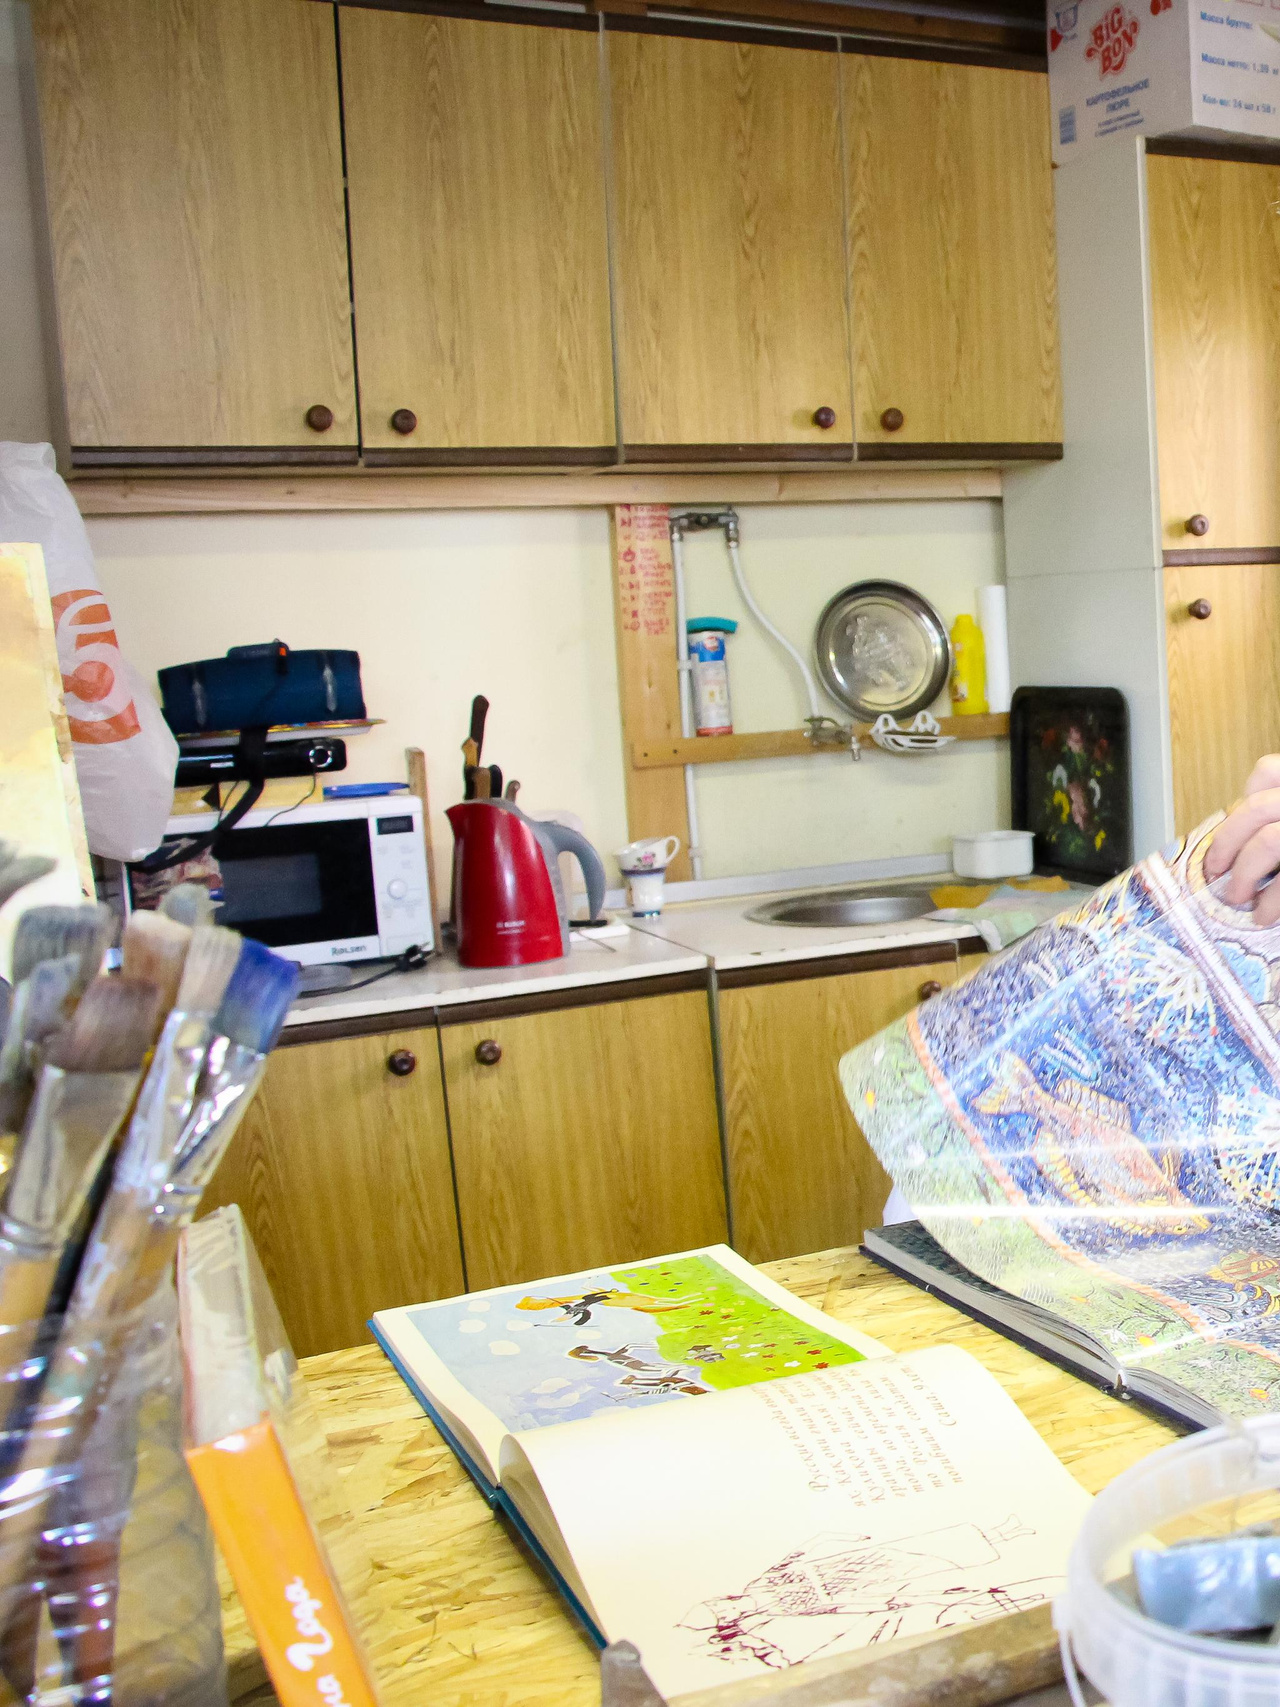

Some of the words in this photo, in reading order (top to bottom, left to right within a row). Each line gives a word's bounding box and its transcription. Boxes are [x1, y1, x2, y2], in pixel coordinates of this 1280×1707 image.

[1200, 11, 1224, 25] Масса
[1201, 52, 1226, 66] Масса
[771, 1409, 801, 1441] всегда
[837, 1406, 869, 1440] сейчас
[850, 1394, 888, 1435] времена
[880, 1406, 898, 1418] не
[815, 1438, 836, 1459] они
[894, 1424, 929, 1466] Россия
[918, 1426, 965, 1485] погибшим
[793, 1442, 831, 1493] Русские
[829, 1459, 852, 1486] Как
[839, 1441, 886, 1504] Куликова
[865, 1447, 907, 1498] границы
[926, 1472, 945, 1489] то
